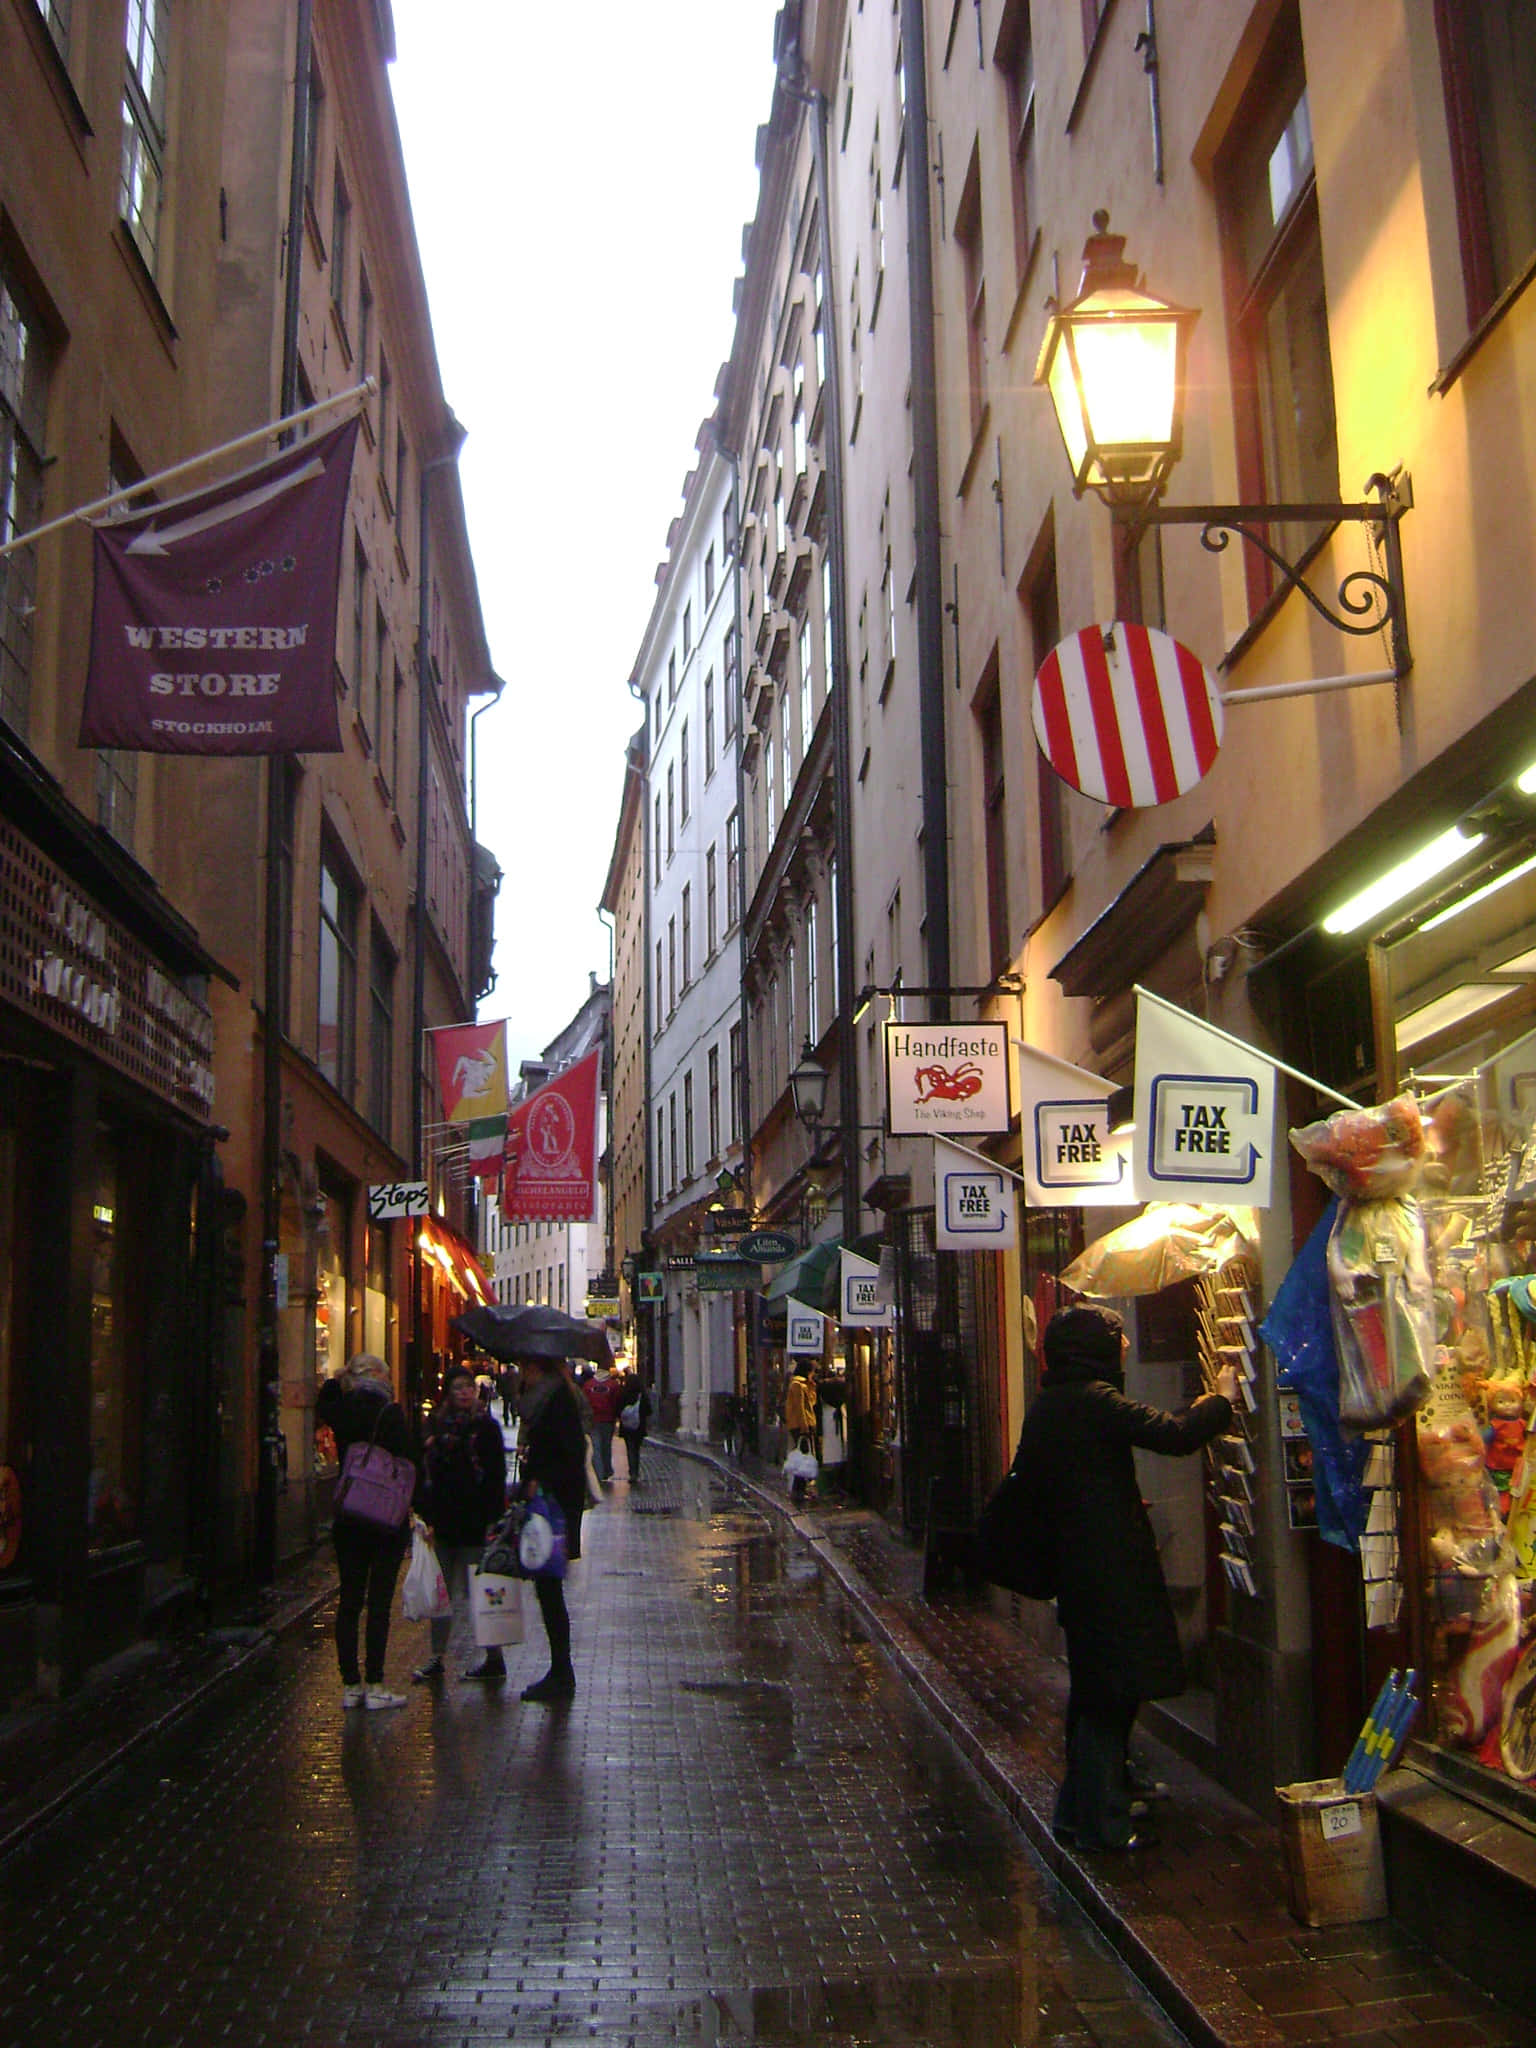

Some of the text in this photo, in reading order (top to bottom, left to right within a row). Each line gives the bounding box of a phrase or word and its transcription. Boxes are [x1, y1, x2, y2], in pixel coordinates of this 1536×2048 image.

[124, 624, 309, 649] WESTERN
[150, 673, 281, 696] STORE
[152, 720, 273, 734] STOCKHOLM
[895, 1034, 999, 1057] Handfaste
[914, 1106, 985, 1120] The Viking Shop
[1181, 1105, 1226, 1129] TAX
[1060, 1124, 1097, 1143] TAX
[1175, 1129, 1231, 1154] FREE
[1057, 1144, 1101, 1163] FREE
[370, 1184, 428, 1216] Steps
[961, 1185, 987, 1198] TAX
[959, 1199, 990, 1212] FREE
[858, 1284, 875, 1293] TAX
